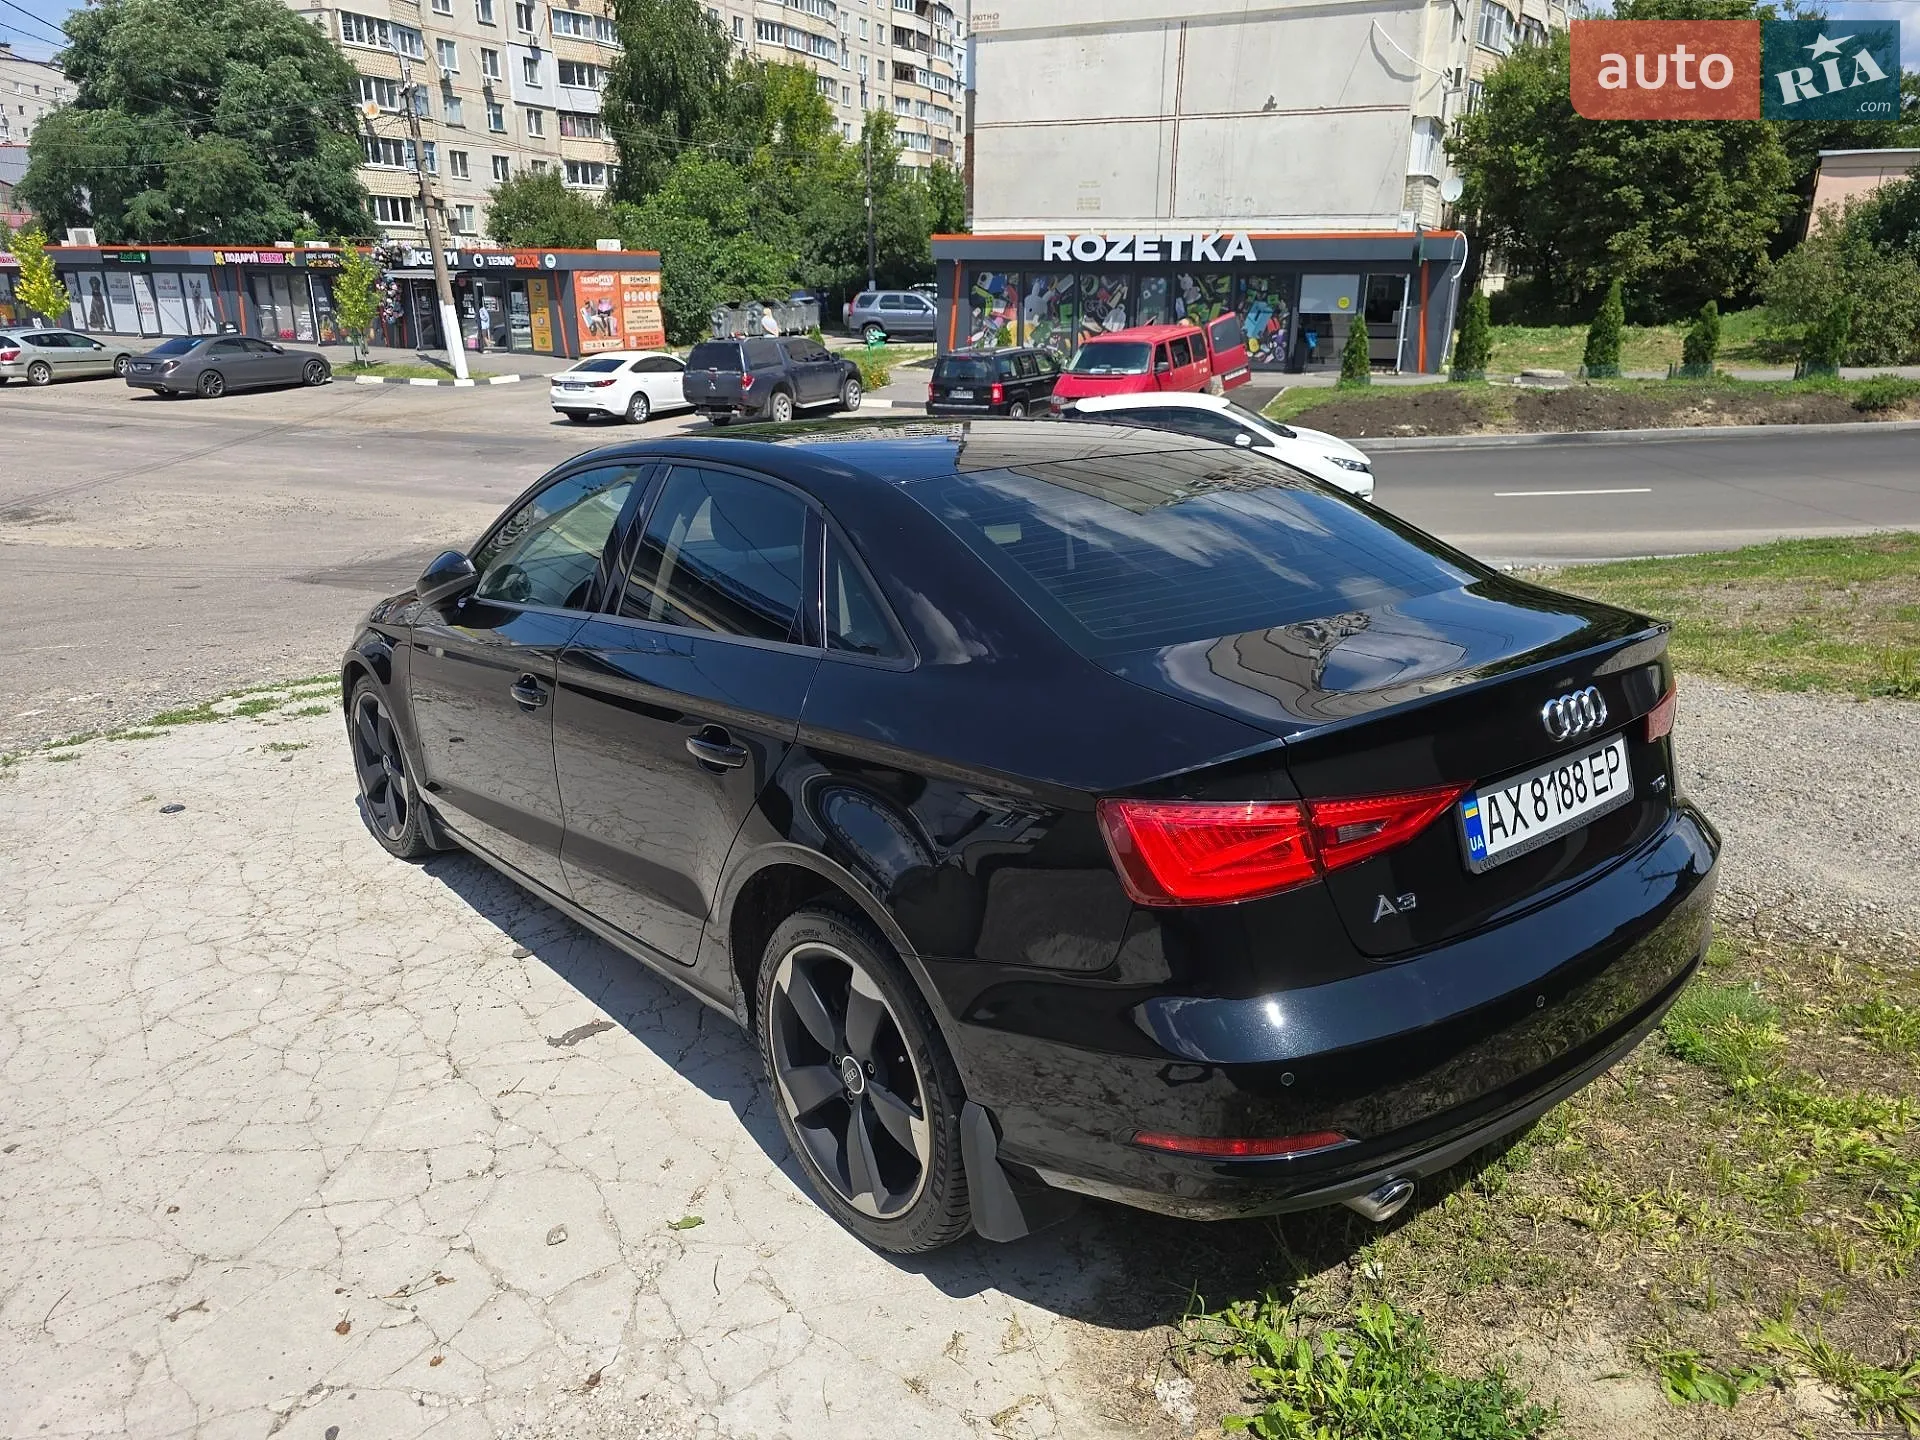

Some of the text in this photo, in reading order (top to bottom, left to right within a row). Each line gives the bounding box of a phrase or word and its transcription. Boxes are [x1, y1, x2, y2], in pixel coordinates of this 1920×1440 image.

[1043, 232, 1257, 262] ROZETKA
[1486, 783, 1529, 845] AX
[1530, 760, 1588, 822] 8188
[1589, 745, 1620, 797] EP
[1469, 836, 1484, 852] UA
[1372, 892, 1416, 923] A3
